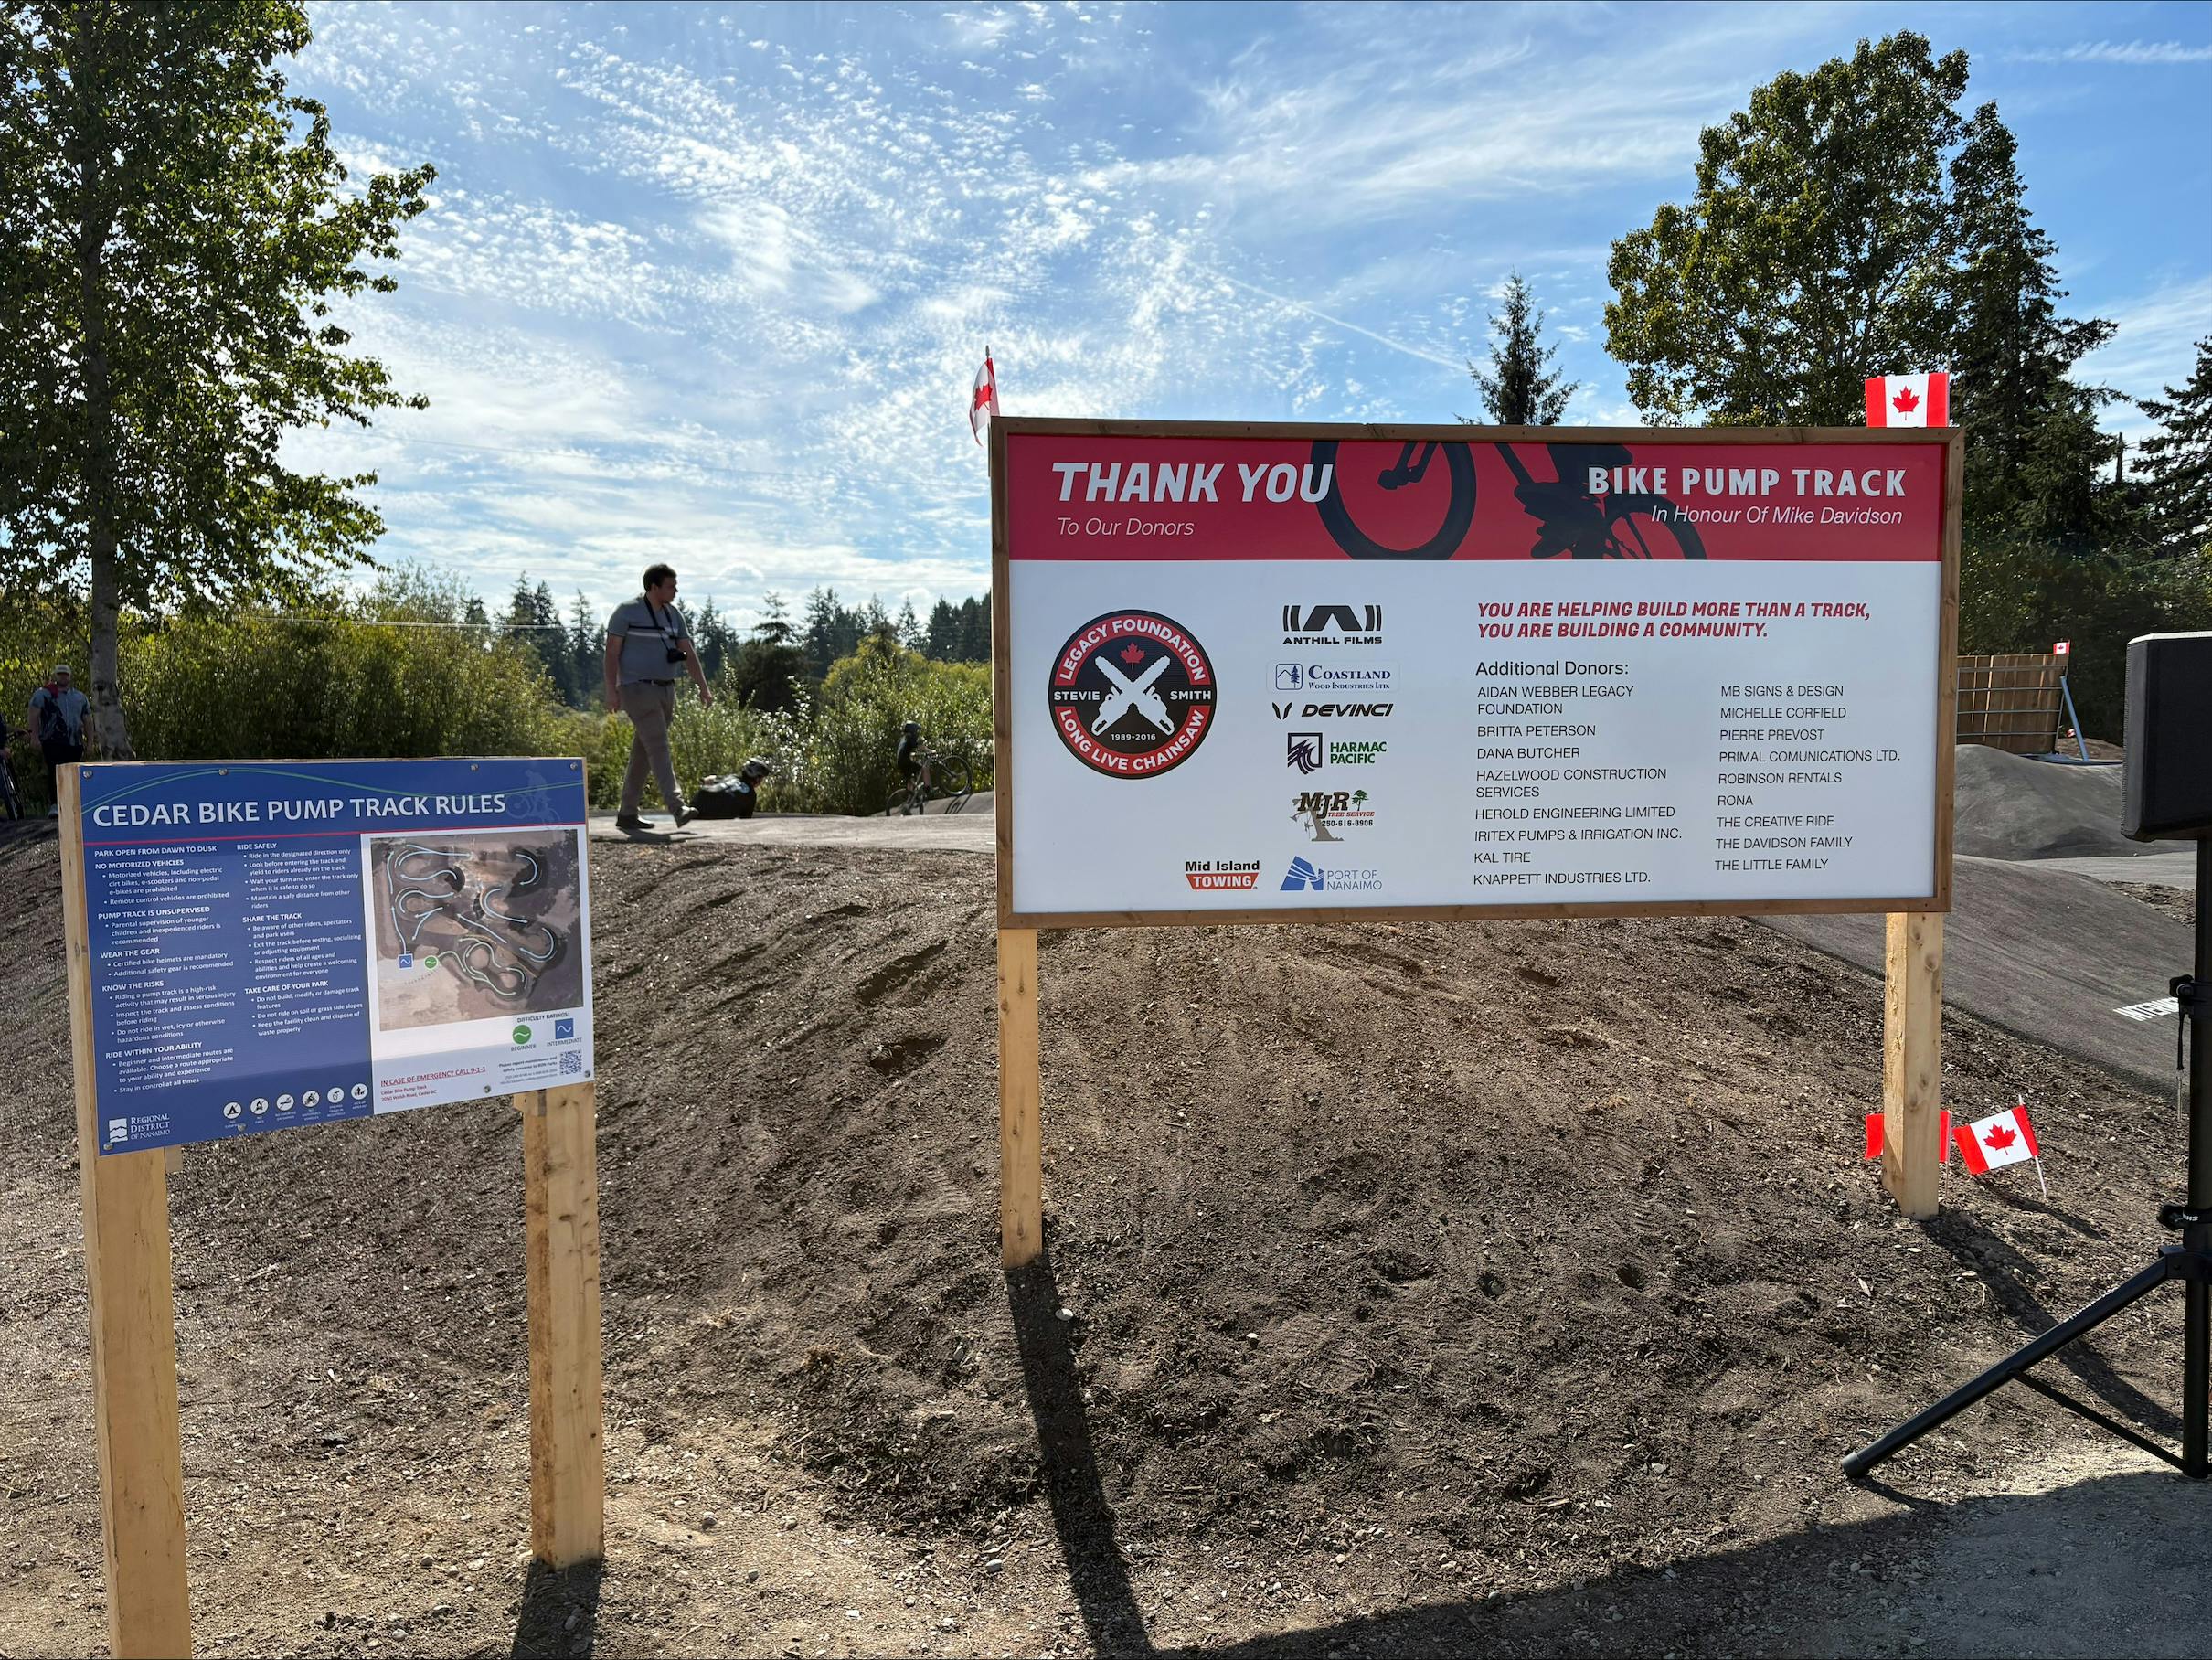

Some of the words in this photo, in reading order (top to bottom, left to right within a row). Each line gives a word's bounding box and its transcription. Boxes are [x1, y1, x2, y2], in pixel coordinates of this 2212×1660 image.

[1052, 462, 1225, 502] THANK
[1237, 463, 1334, 503] YOU
[1588, 467, 1667, 495] BIKE
[1682, 468, 1780, 495] PUMP
[1792, 469, 1906, 496] TRACK
[1651, 505, 1667, 522] In
[1674, 505, 1742, 523] Honour
[1746, 505, 1770, 523] Of
[1772, 506, 1814, 524] Mike
[1820, 506, 1902, 524] Davidson
[1058, 517, 1079, 535] To
[1085, 517, 1122, 535] Our
[1125, 517, 1194, 536] Donors
[1478, 602, 1514, 617] YOU
[1516, 602, 1554, 617] ARE
[1557, 601, 1632, 617] HELPING
[1636, 601, 1687, 617] BUILD
[1691, 601, 1740, 617] MORE
[1745, 602, 1792, 617] THAN
[1794, 602, 1805, 617] A
[1811, 602, 1870, 621] TRACK,
[1478, 623, 1514, 638] YOU
[1516, 622, 1553, 637] ARE
[1557, 622, 1640, 637] BUILDING
[1643, 622, 1654, 637] A
[1659, 622, 1767, 637] COMMUNITY.
[1282, 636, 1340, 644] ANTHILL
[1344, 636, 1382, 644] FILMS
[1059, 624, 1108, 681] LEGACY
[1112, 619, 1207, 682] FOUNDATION
[1475, 660, 1558, 676] Additional
[1565, 661, 1628, 675] Donors:
[1054, 691, 1100, 700] STEVIE
[1170, 690, 1211, 700] SMITH
[1477, 686, 1517, 697] AIDAN
[1521, 686, 1578, 697] WEBBER
[1582, 686, 1634, 697] LEGACY
[1721, 686, 1740, 697] MB
[1744, 686, 1782, 697] SIGNS
[1786, 686, 1794, 697] &
[1798, 685, 1844, 697] DESIGN
[1301, 703, 1394, 718] DEVINCI
[1478, 702, 1562, 715] FOUNDATION
[1720, 708, 1782, 718] MICHELLE
[1786, 707, 1846, 718] CORFIELD
[1477, 725, 1523, 737] BRITTA
[1526, 724, 1596, 737] PETERSON
[1719, 729, 1764, 740] PIERRE
[1768, 729, 1825, 740] PREVOST
[1059, 709, 1091, 754] LONG
[1091, 748, 1128, 770] LIVE
[1133, 709, 1205, 771] CHAINSAW
[1330, 741, 1387, 753] HARMAC
[1477, 748, 1514, 759] DANA
[1517, 747, 1580, 759] BUTCHER
[1330, 752, 1376, 764] PACIFIC
[1719, 751, 1766, 762] PRIMAL
[1769, 750, 1872, 762] COMUNICATIONS
[1876, 750, 1900, 761] LTD.
[1476, 769, 1559, 782] HAZELWOOD
[1563, 768, 1666, 781] CONSTRUCTION
[1718, 772, 1784, 784] ROBINSON
[1788, 771, 1842, 783] RENTALS
[1475, 786, 1539, 798] SERVICES
[1717, 794, 1753, 806] RONA
[92, 804, 190, 826] CEDAR
[198, 802, 260, 823] BIKE
[268, 799, 344, 821] PUMP
[350, 796, 430, 816] TRACK
[435, 794, 505, 814] RULES
[1475, 808, 1529, 820] HEROLD
[1533, 806, 1622, 819] ENGINEERING
[1625, 806, 1675, 818] LIMITED
[1717, 816, 1741, 827] THE
[1744, 815, 1803, 827] CREATIVE
[1806, 815, 1834, 826] RIDE
[1474, 830, 1515, 842] IRITEX
[1518, 829, 1565, 841] PUMPS
[1569, 829, 1577, 840] &
[1580, 828, 1653, 840] IRRIGATION
[1656, 827, 1682, 839] INC.
[1715, 838, 1740, 849] THE
[1743, 837, 1806, 849] DAVIDSON
[1810, 836, 1853, 847] FAMILY
[108, 860, 151, 868] MOTORIZED
[151, 858, 184, 867] VEHICLES
[1474, 852, 1499, 863] KAL
[1502, 851, 1531, 863] TIRE
[1186, 861, 1210, 872] Mid
[1216, 860, 1260, 871] Island
[1714, 859, 1739, 870] THE
[1742, 858, 1782, 870] LITTLE
[1786, 858, 1829, 869] FAMILY
[1327, 870, 1357, 879] PORT
[1361, 870, 1377, 879] OF
[1473, 873, 1541, 885] KNAPPETT
[1625, 871, 1651, 883] LTD.
[1193, 876, 1252, 888] TOWING
[1327, 880, 1382, 890] NANAIMO
[242, 915, 264, 923] SHARE
[100, 951, 122, 959] WEAR
[101, 984, 126, 992] KNOW
[144, 980, 164, 988] RISKS
[262, 984, 280, 993] CARE
[105, 1050, 122, 1059] RIDE
[123, 1048, 152, 1057] WITHIN
[154, 1045, 175, 1053] YOUR
[175, 1041, 202, 1050] ABILITY
